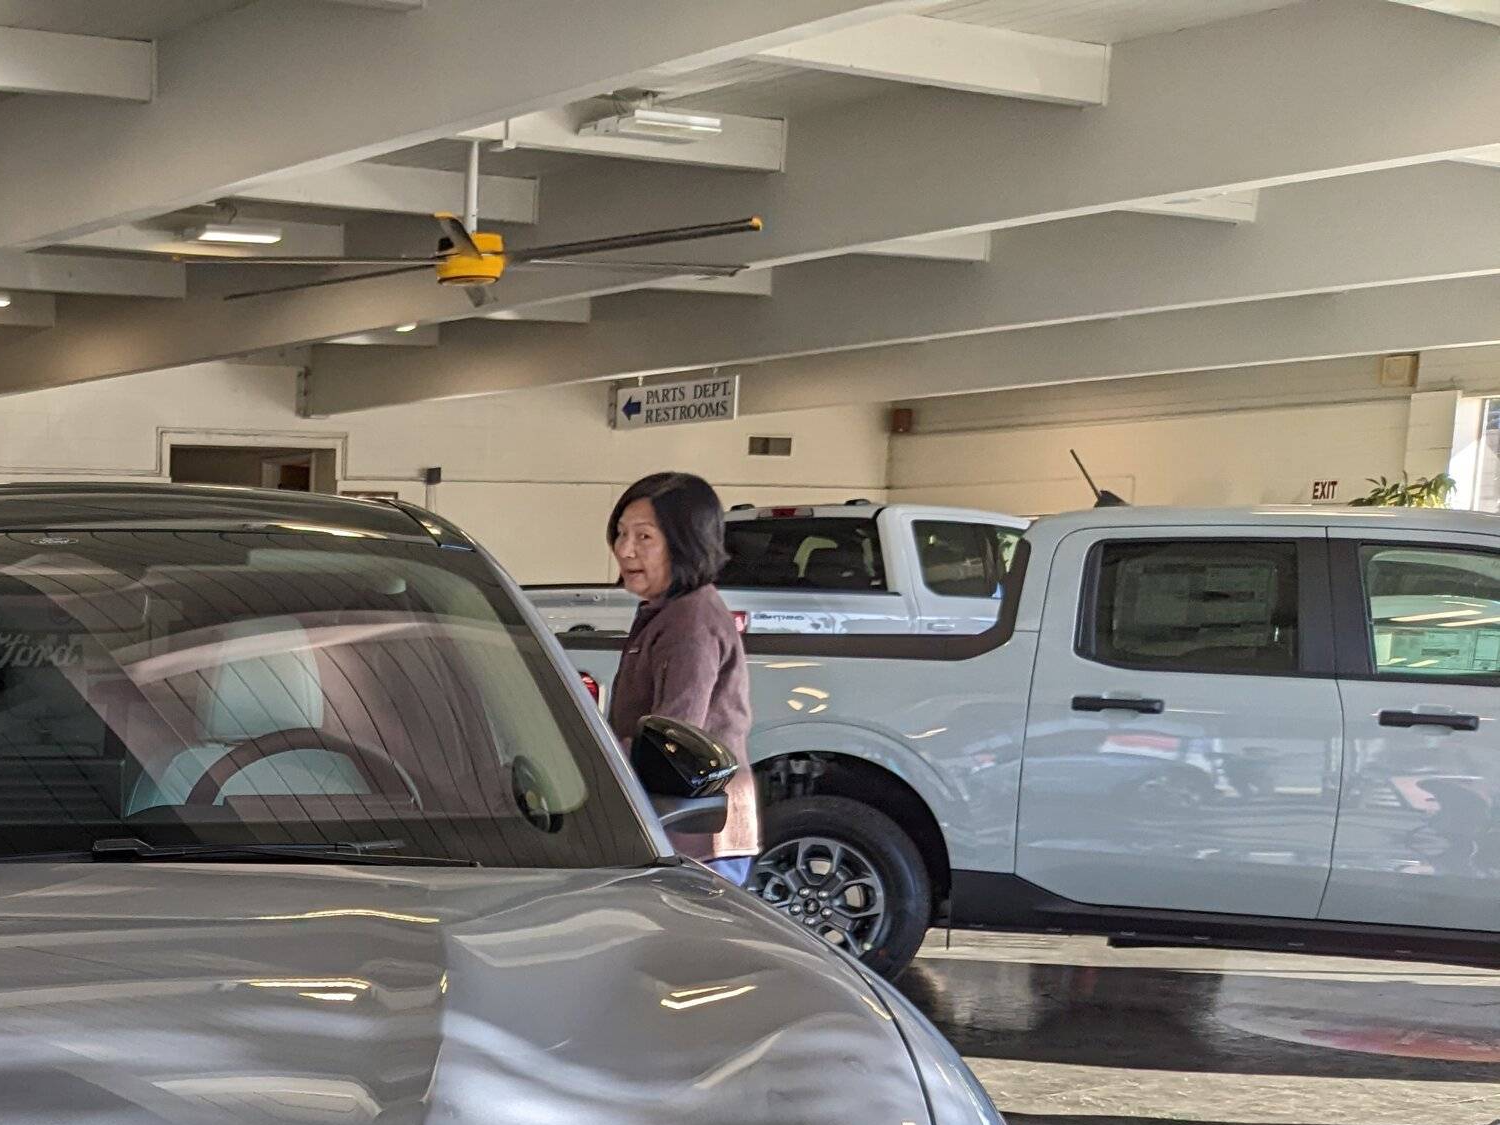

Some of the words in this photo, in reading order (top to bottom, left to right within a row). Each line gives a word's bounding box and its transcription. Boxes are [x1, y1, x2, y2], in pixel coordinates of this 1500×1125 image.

[646, 387, 685, 404] PARTS
[693, 381, 731, 399] DEPT.
[645, 401, 728, 423] RESTROOMS
[1312, 480, 1338, 500] EXIT
